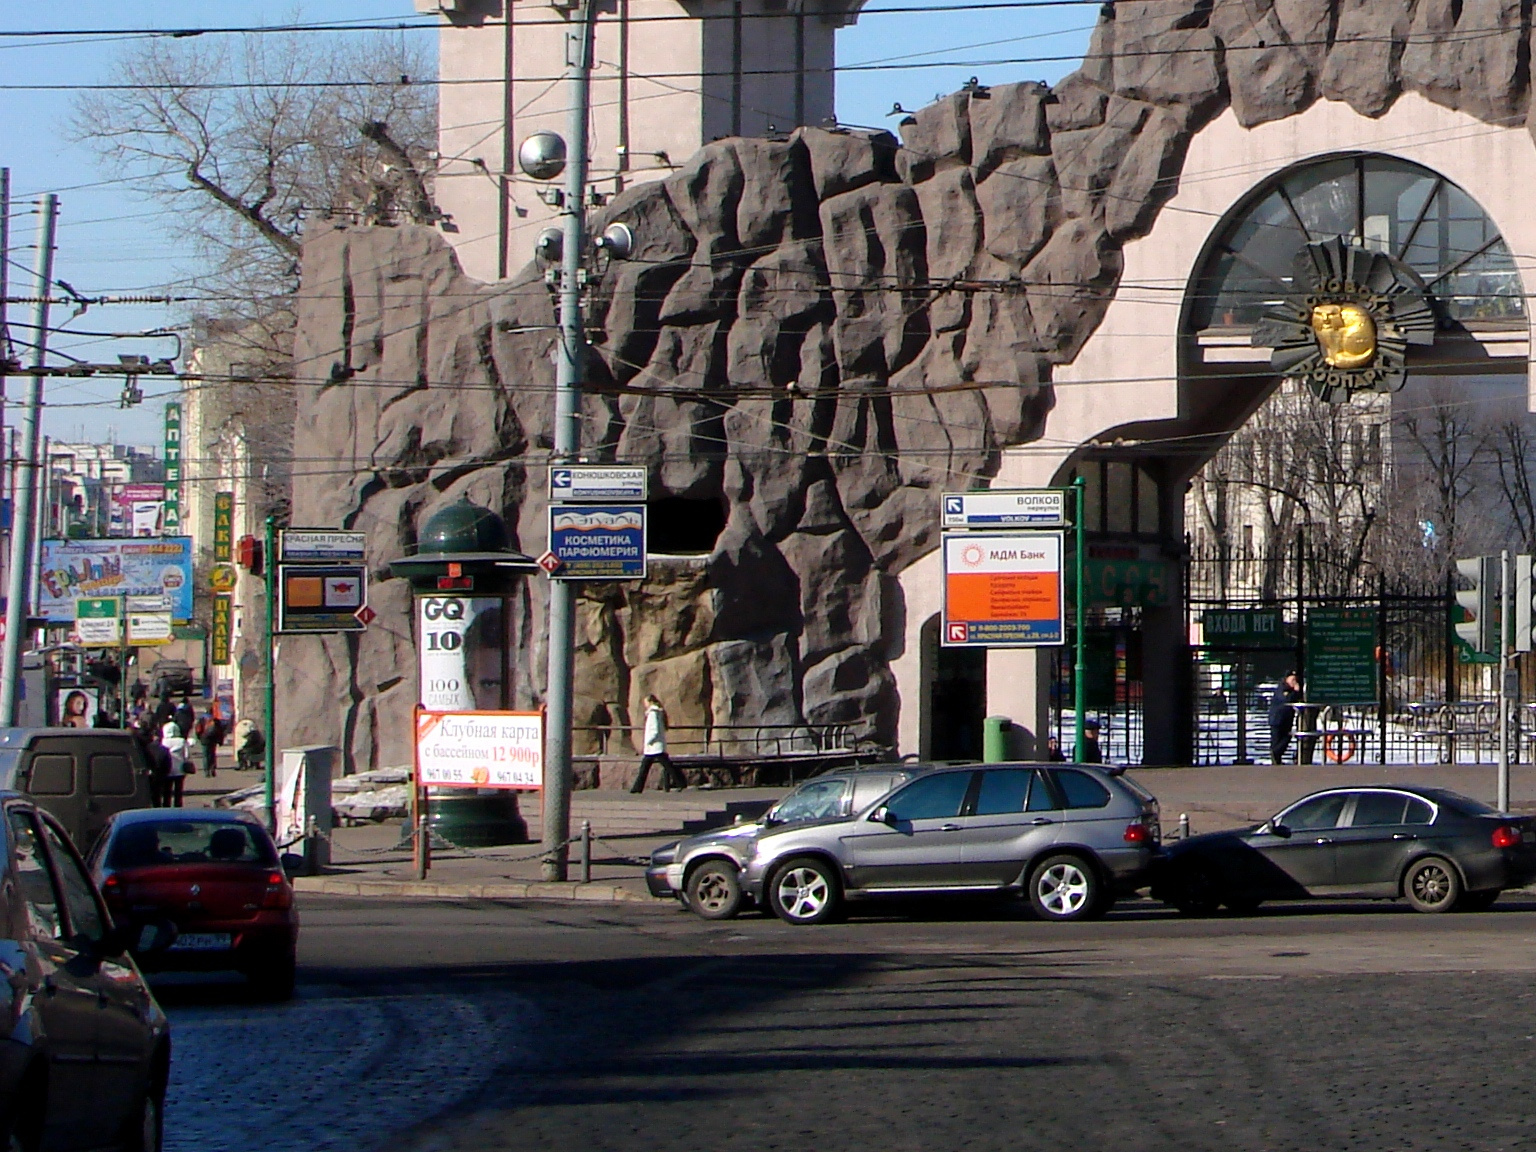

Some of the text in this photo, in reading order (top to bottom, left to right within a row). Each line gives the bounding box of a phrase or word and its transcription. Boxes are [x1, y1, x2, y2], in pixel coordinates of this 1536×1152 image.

[166, 408, 180, 522] АПТЕКА
[572, 471, 643, 479] КОНЮШКОВСКАЯ
[1017, 496, 1060, 505] ВОЛКОВ
[286, 535, 365, 543] КРАСНАЯ ПРЕСНЯ
[565, 535, 632, 545] КОСМЕТИКА
[558, 546, 639, 557] ПАРФЮМЕРИЯ
[990, 550, 1045, 560] МДМ Банк
[425, 598, 466, 621] GQ
[1253, 613, 1276, 632] НЕТ
[427, 630, 462, 651] 10
[430, 679, 459, 692] 100
[440, 719, 539, 745] Клубная карта
[425, 743, 540, 768] с бассейном 12 900р
